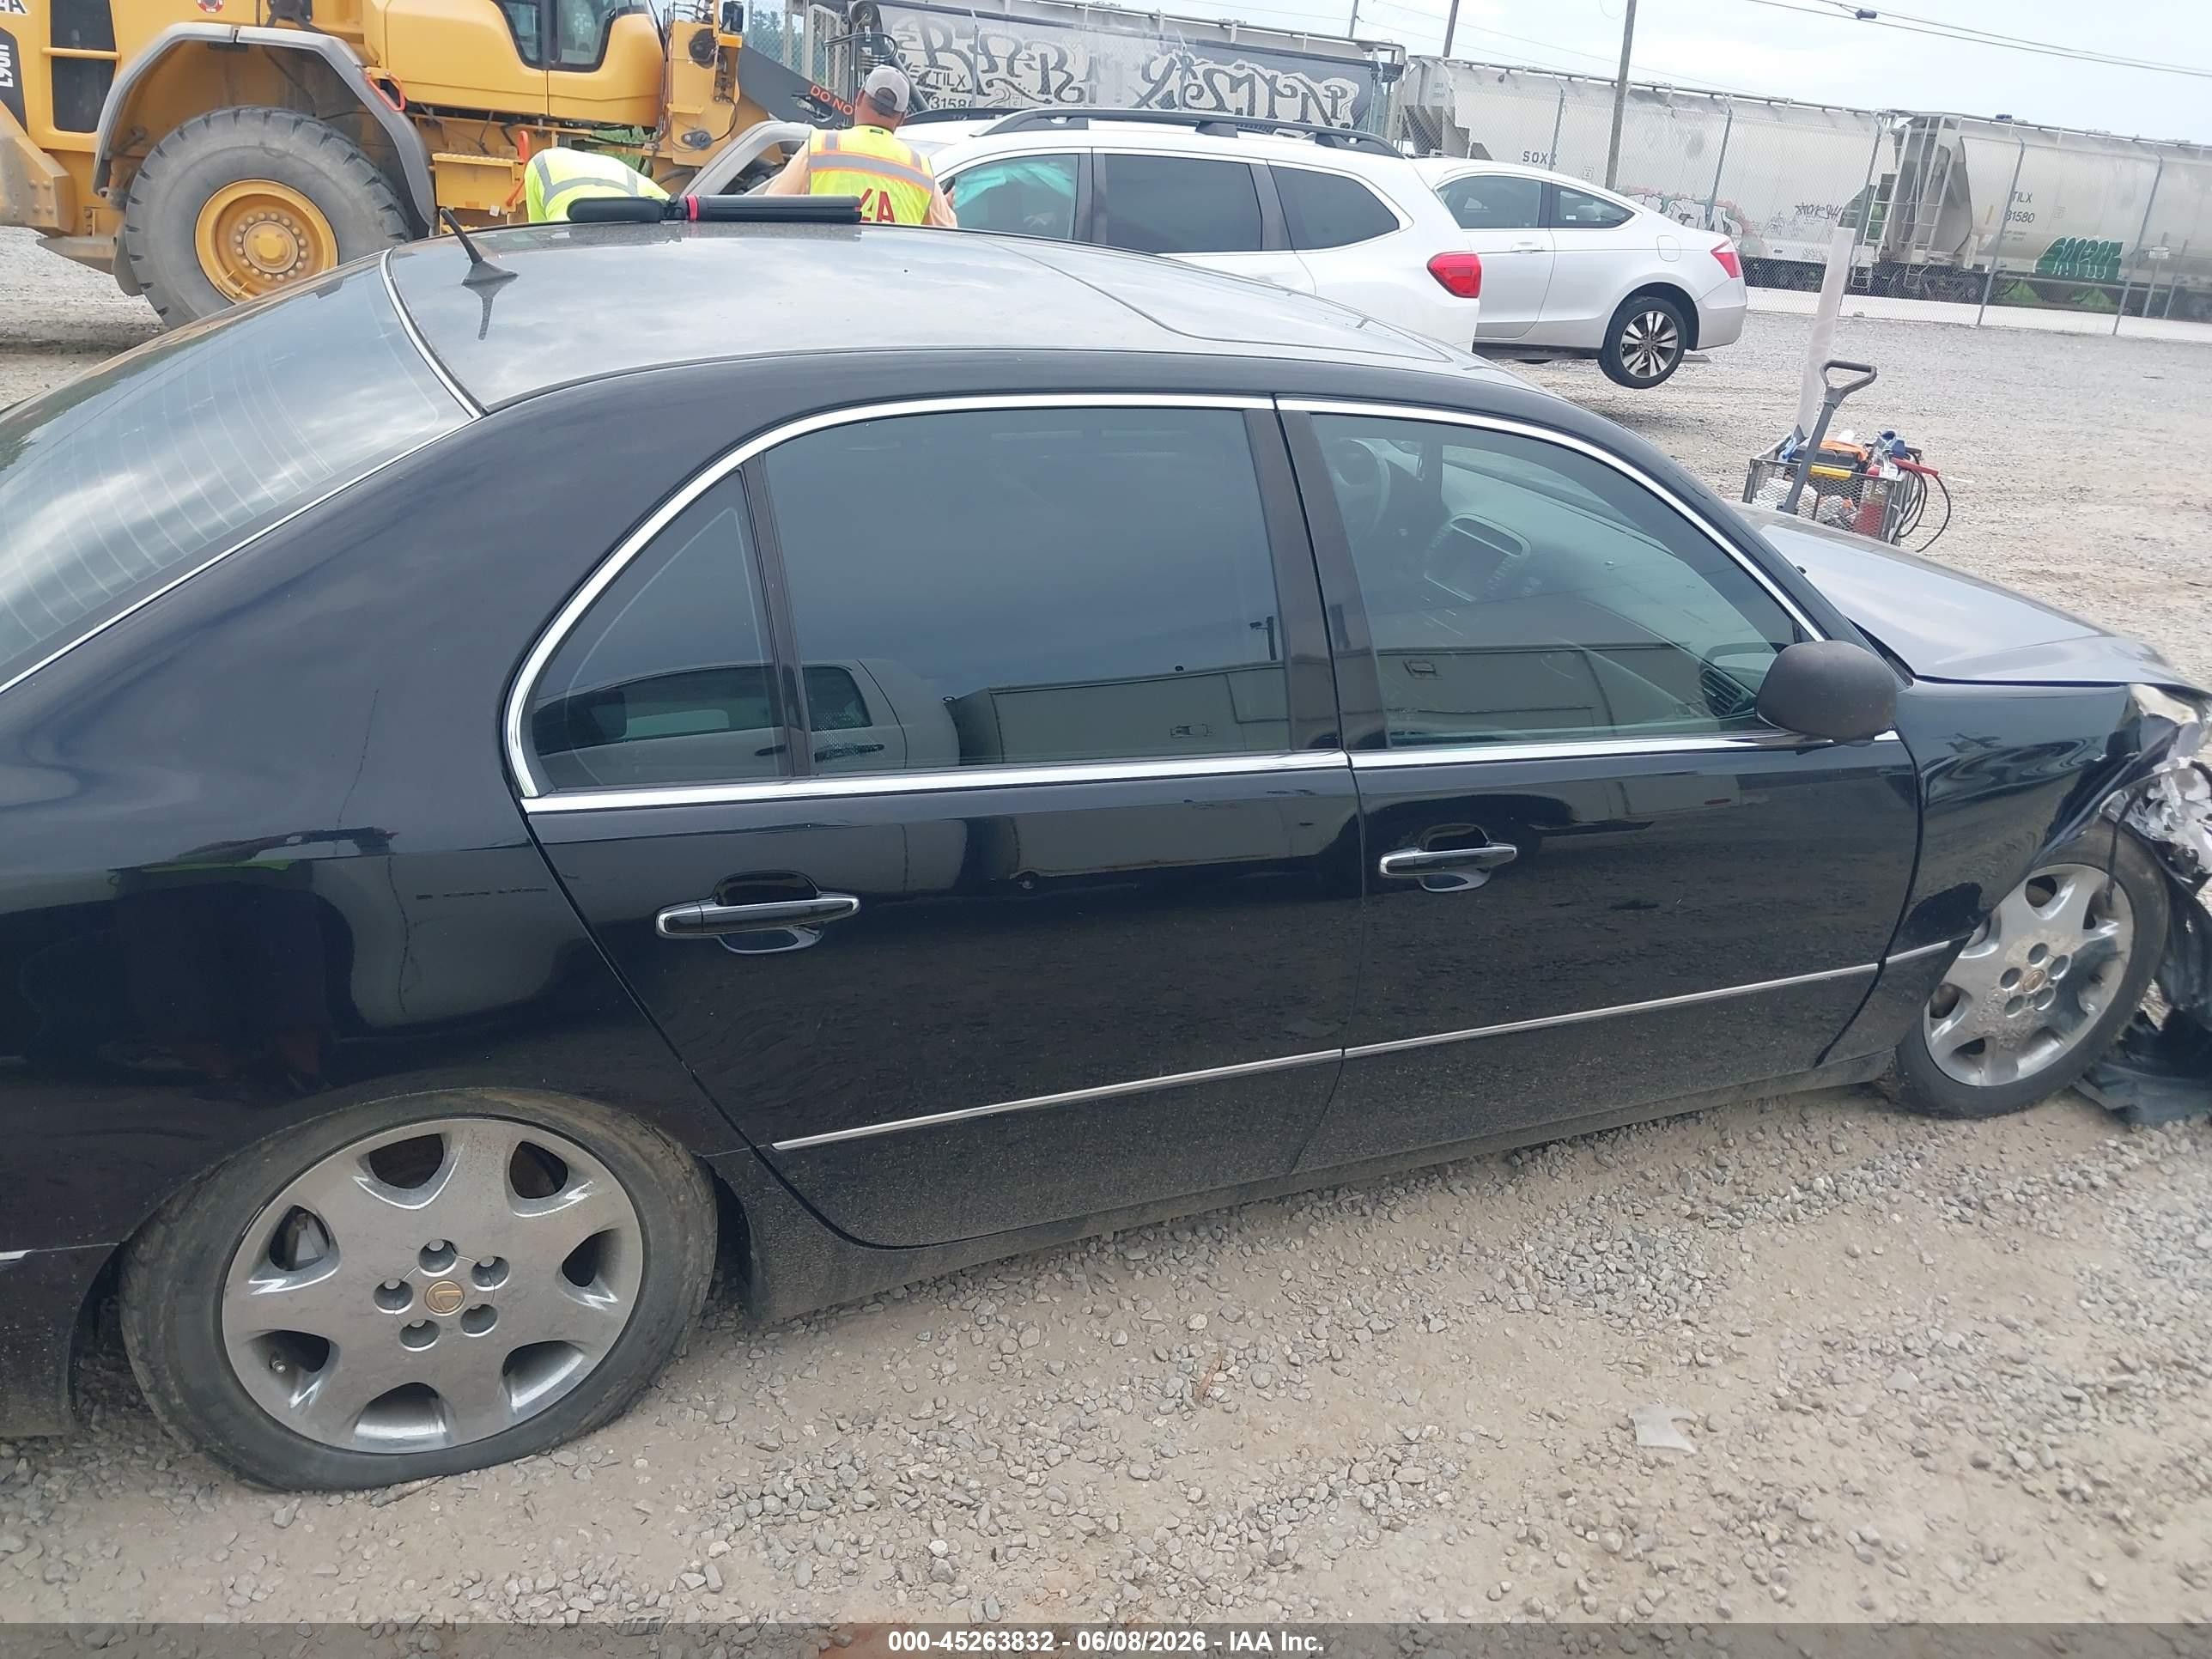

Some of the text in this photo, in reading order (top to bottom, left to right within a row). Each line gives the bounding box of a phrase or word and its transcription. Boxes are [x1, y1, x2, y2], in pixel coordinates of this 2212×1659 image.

[933, 70, 966, 88] TILX
[811, 85, 854, 115] DO NO
[2013, 191, 2033, 204] TILX
